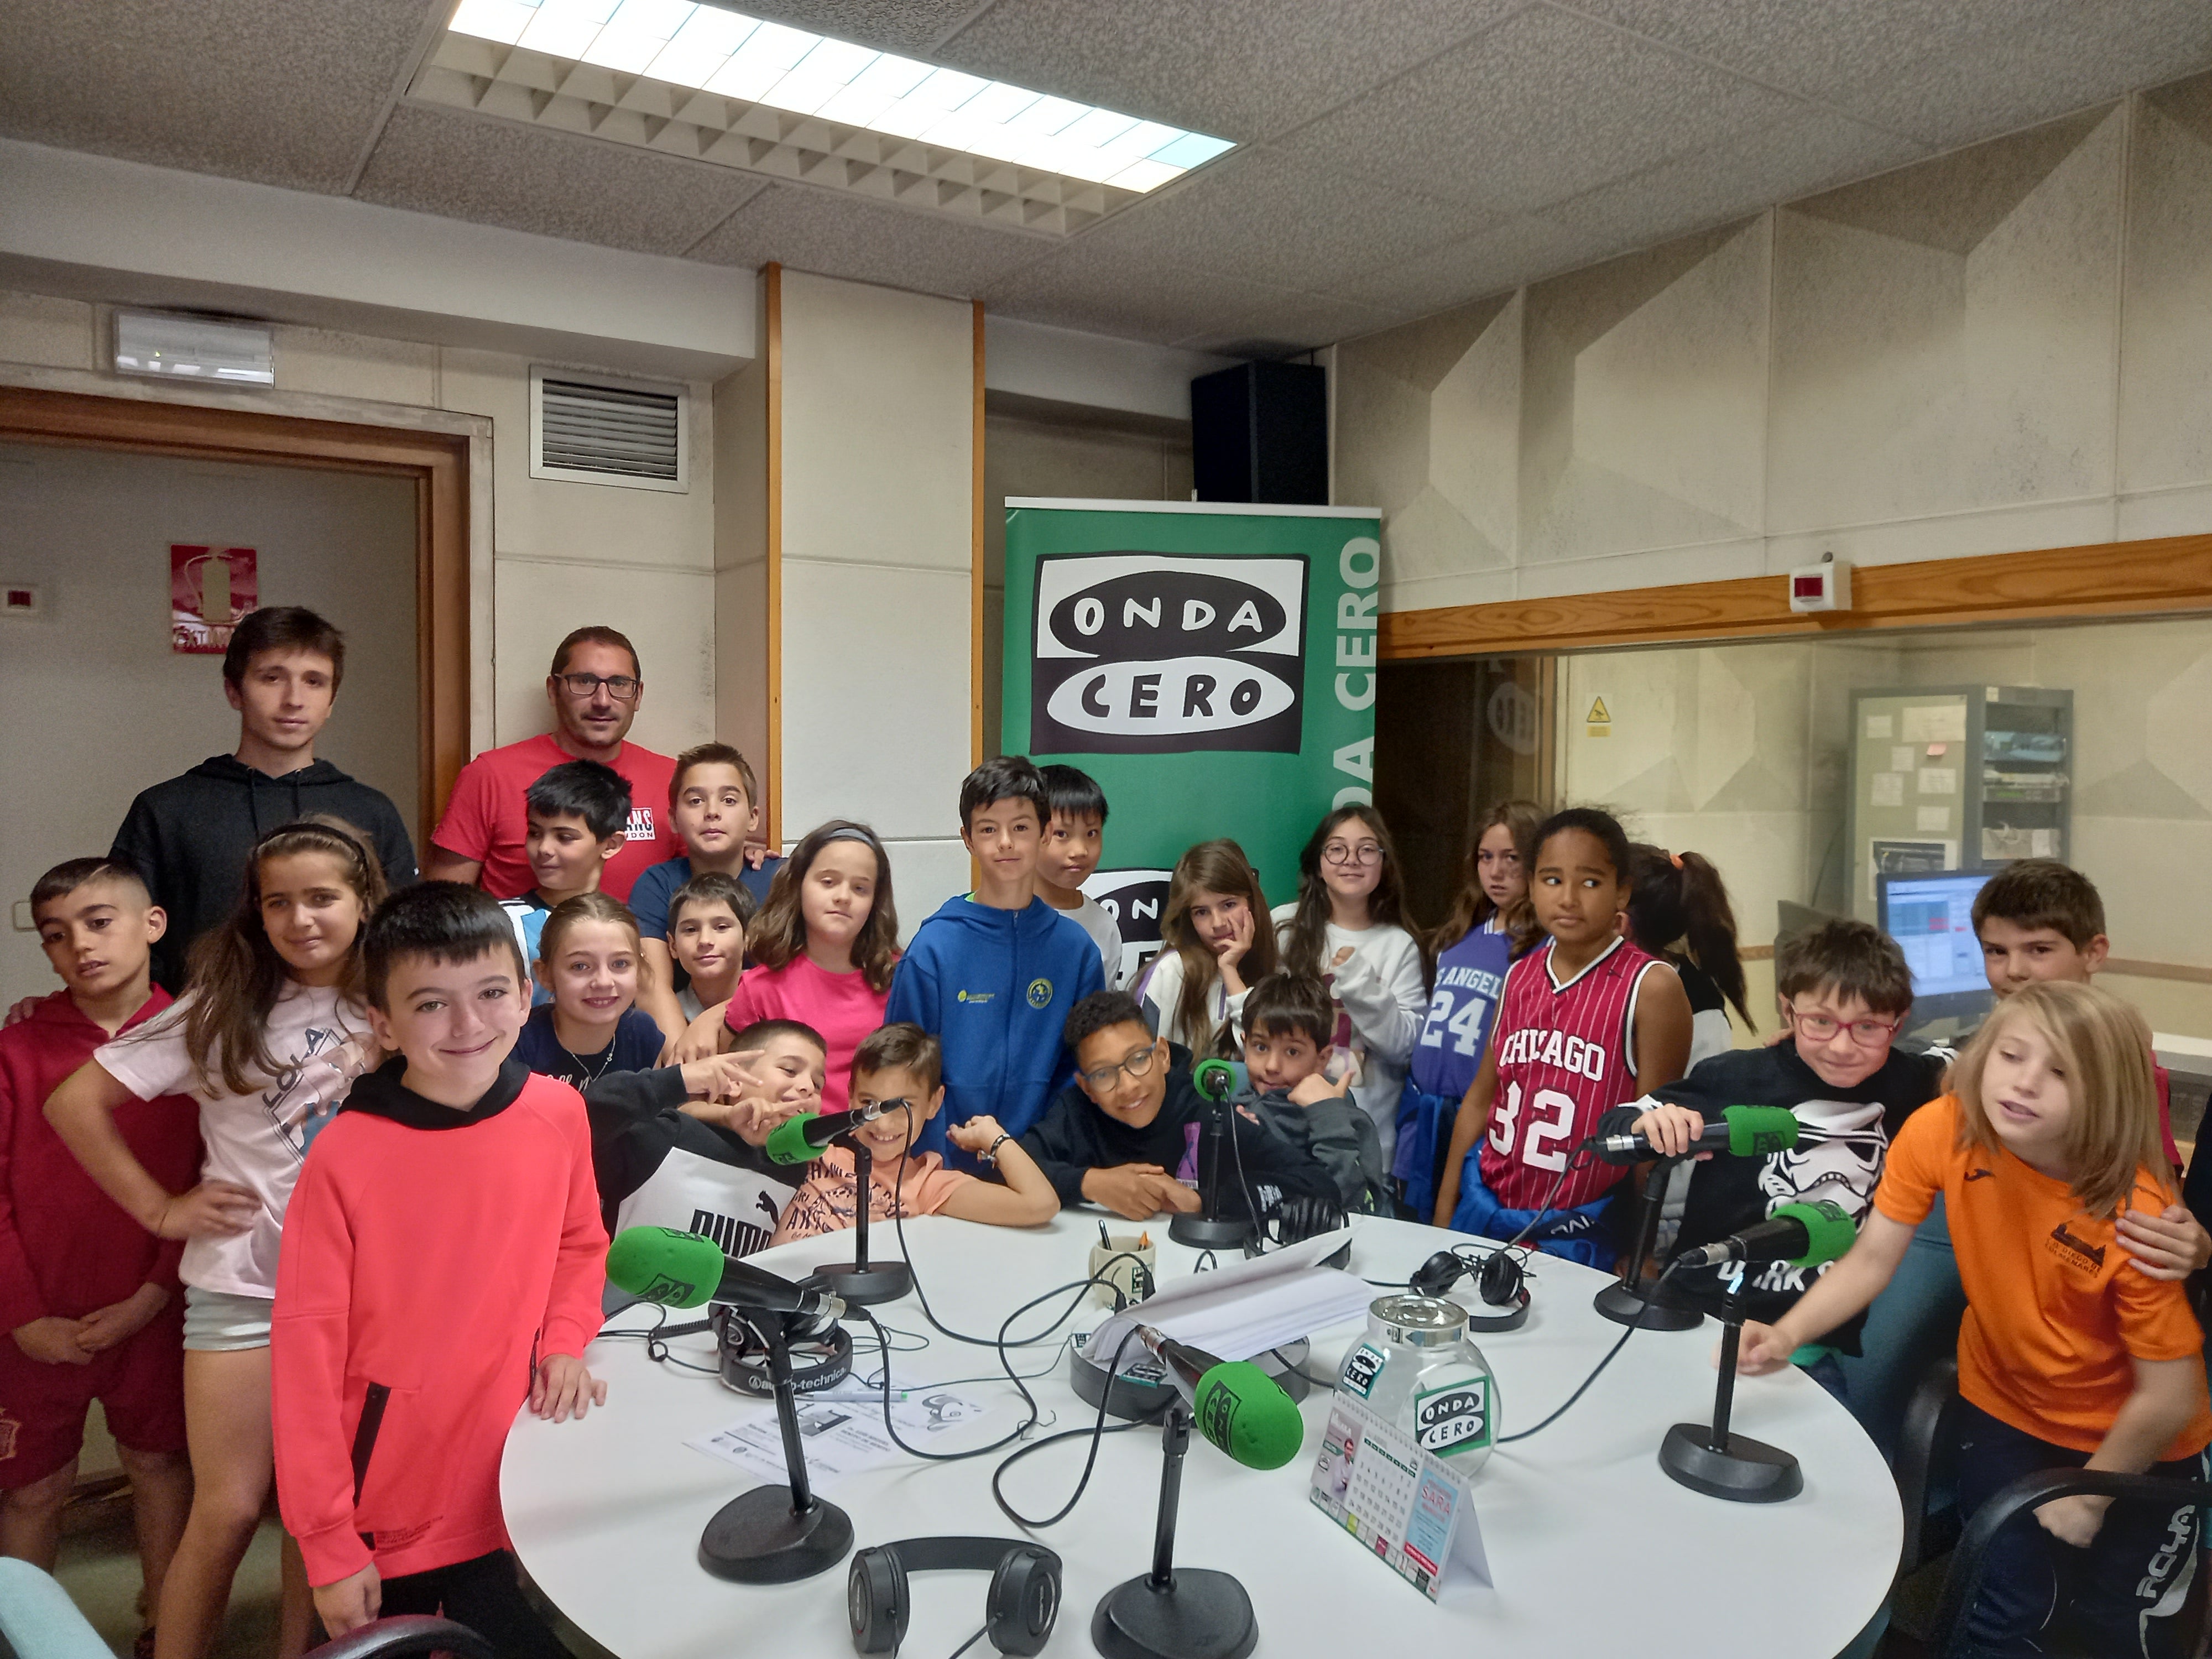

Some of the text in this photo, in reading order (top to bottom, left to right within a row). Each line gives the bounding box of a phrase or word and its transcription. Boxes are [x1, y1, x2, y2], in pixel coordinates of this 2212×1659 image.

[1073, 597, 1262, 635] ONDA
[1332, 536, 1380, 811] DA CERO
[1081, 673, 1262, 718] CERO
[1099, 898, 1158, 921] ON
[1442, 967, 1501, 999] ANGEL
[1420, 990, 1488, 1057] 24
[262, 1028, 325, 1108] LOLA
[1499, 1029, 1605, 1082] CHICAGO
[1489, 1081, 1576, 1172] 32
[761, 1366, 847, 1390] auo-technica
[1347, 1368, 1368, 1385] CERO
[1426, 1396, 1475, 1420] ONDA
[1429, 1421, 1475, 1443] CERO
[1422, 1485, 1451, 1516] SARA
